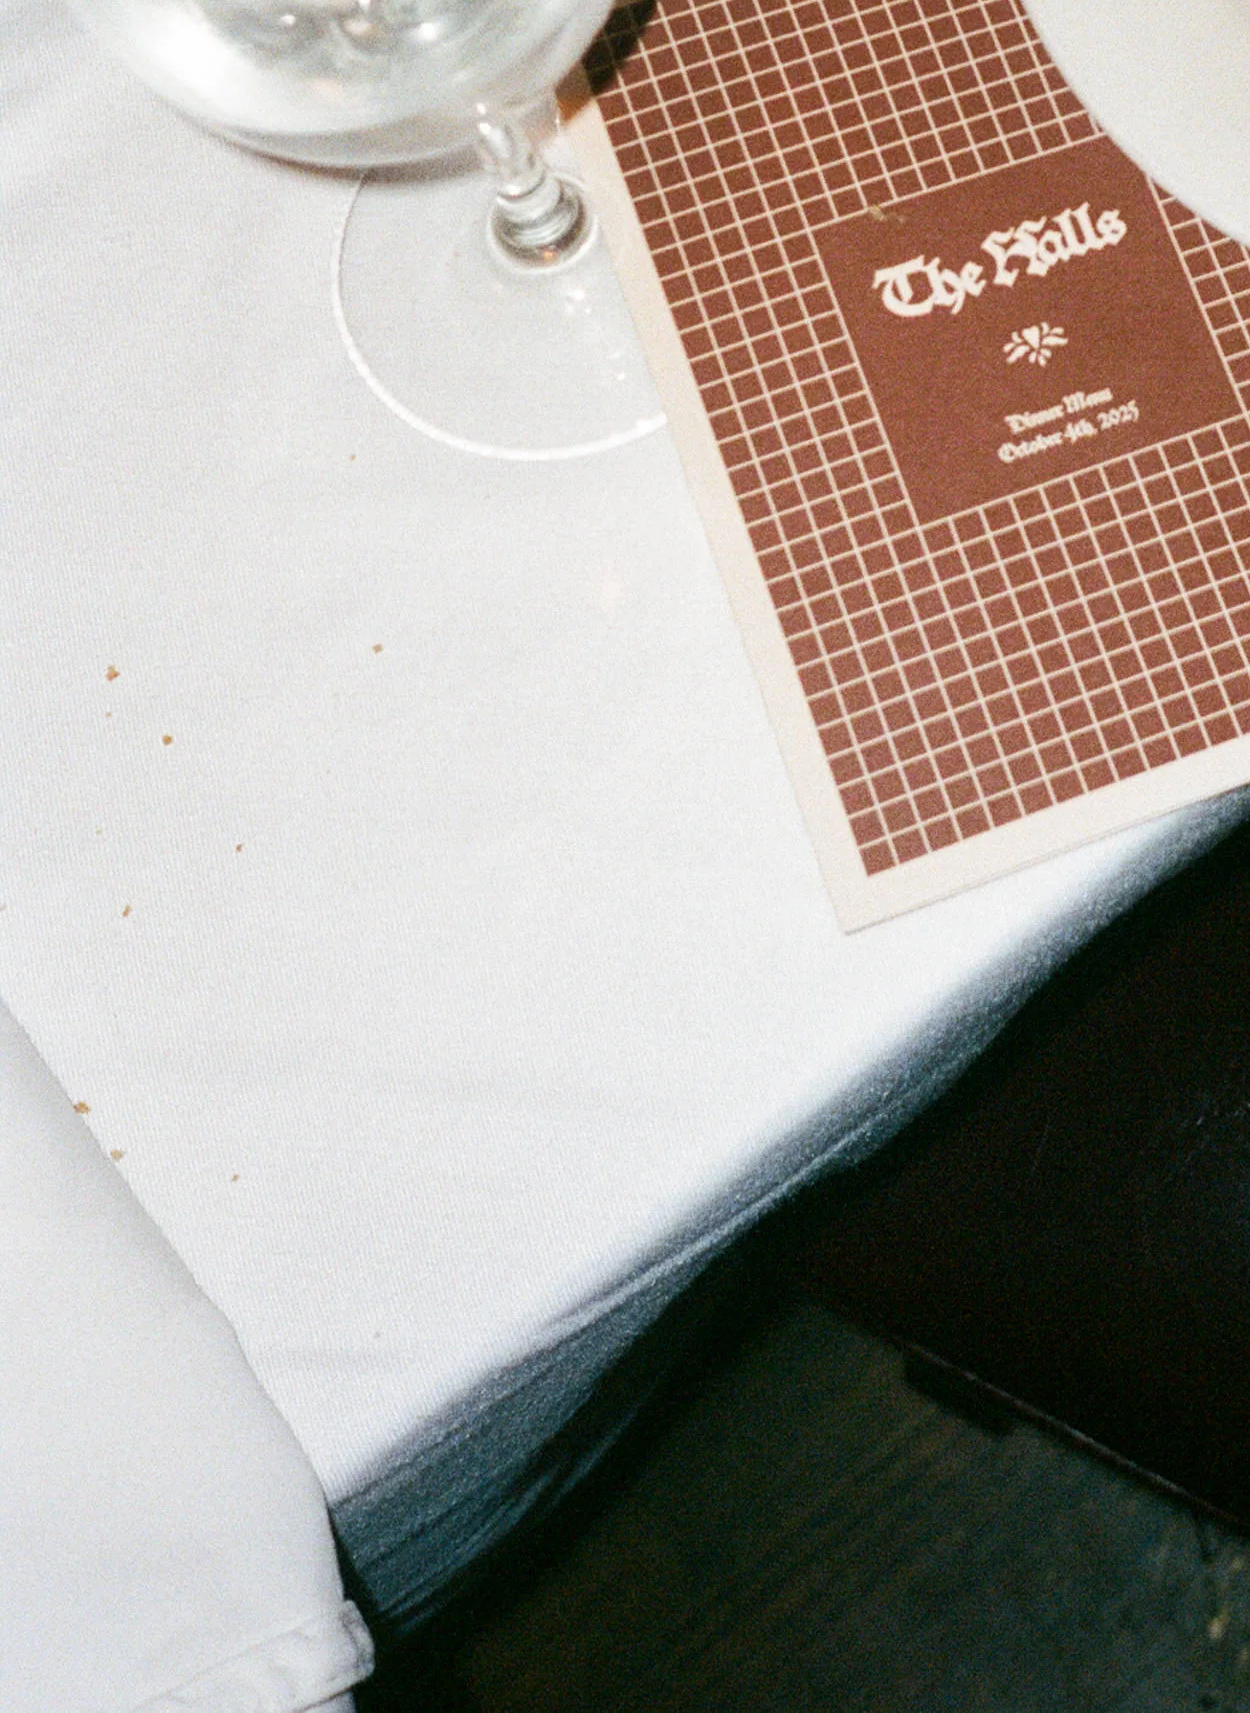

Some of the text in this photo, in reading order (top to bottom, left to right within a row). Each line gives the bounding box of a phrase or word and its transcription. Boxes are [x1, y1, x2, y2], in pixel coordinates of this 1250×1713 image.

[872, 201, 1128, 317] The Halls
[997, 432, 1063, 463] October
[1096, 399, 1139, 431] 2025
[1003, 387, 1114, 435] Dinner Menu
